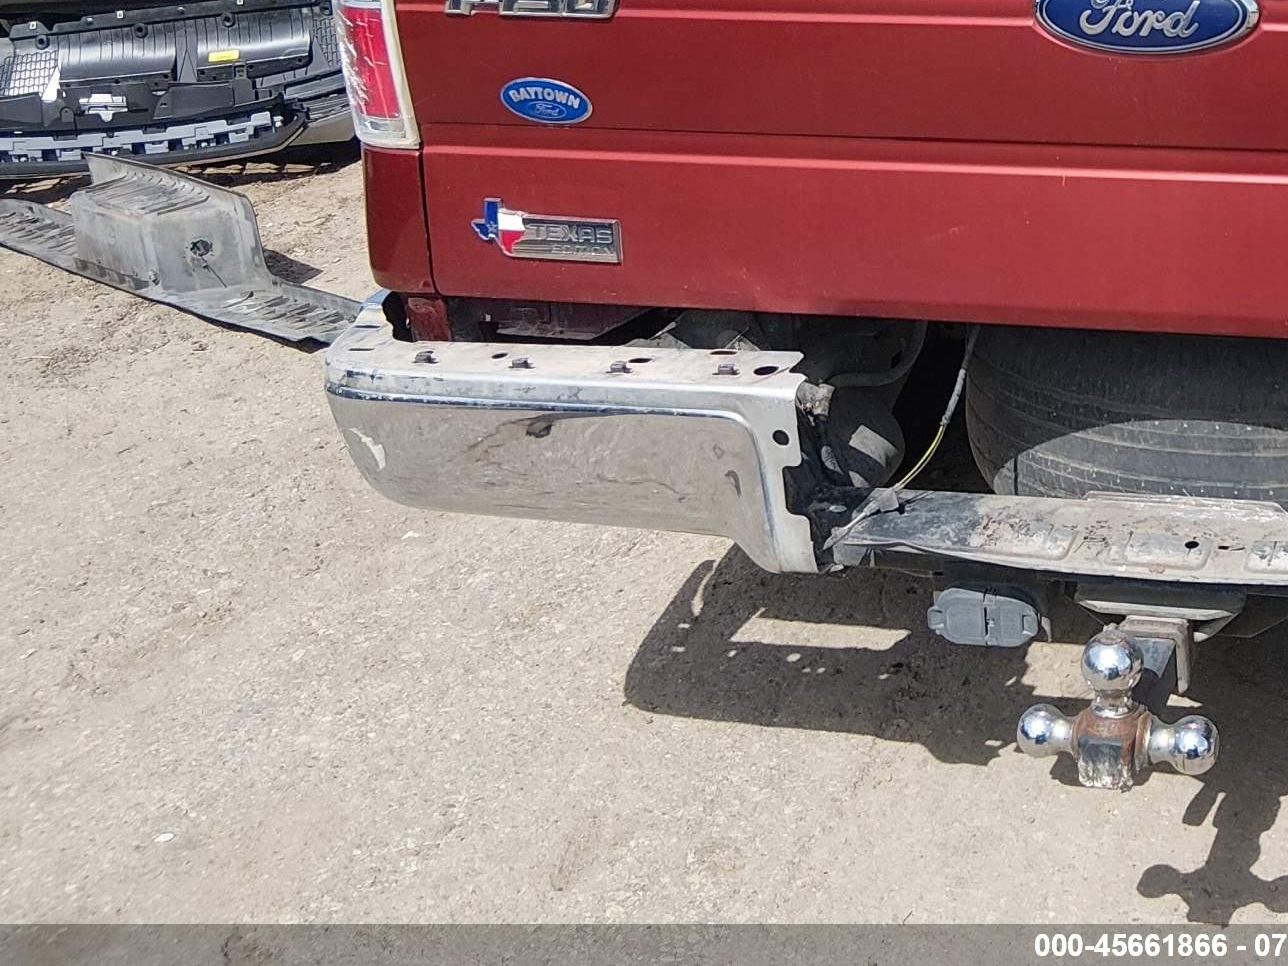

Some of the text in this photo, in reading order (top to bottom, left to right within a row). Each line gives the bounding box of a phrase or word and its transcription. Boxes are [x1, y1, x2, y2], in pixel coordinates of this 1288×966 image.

[508, 86, 581, 110] BAYTOWN
[534, 103, 561, 117] Ford
[524, 222, 614, 244] TEXAS
